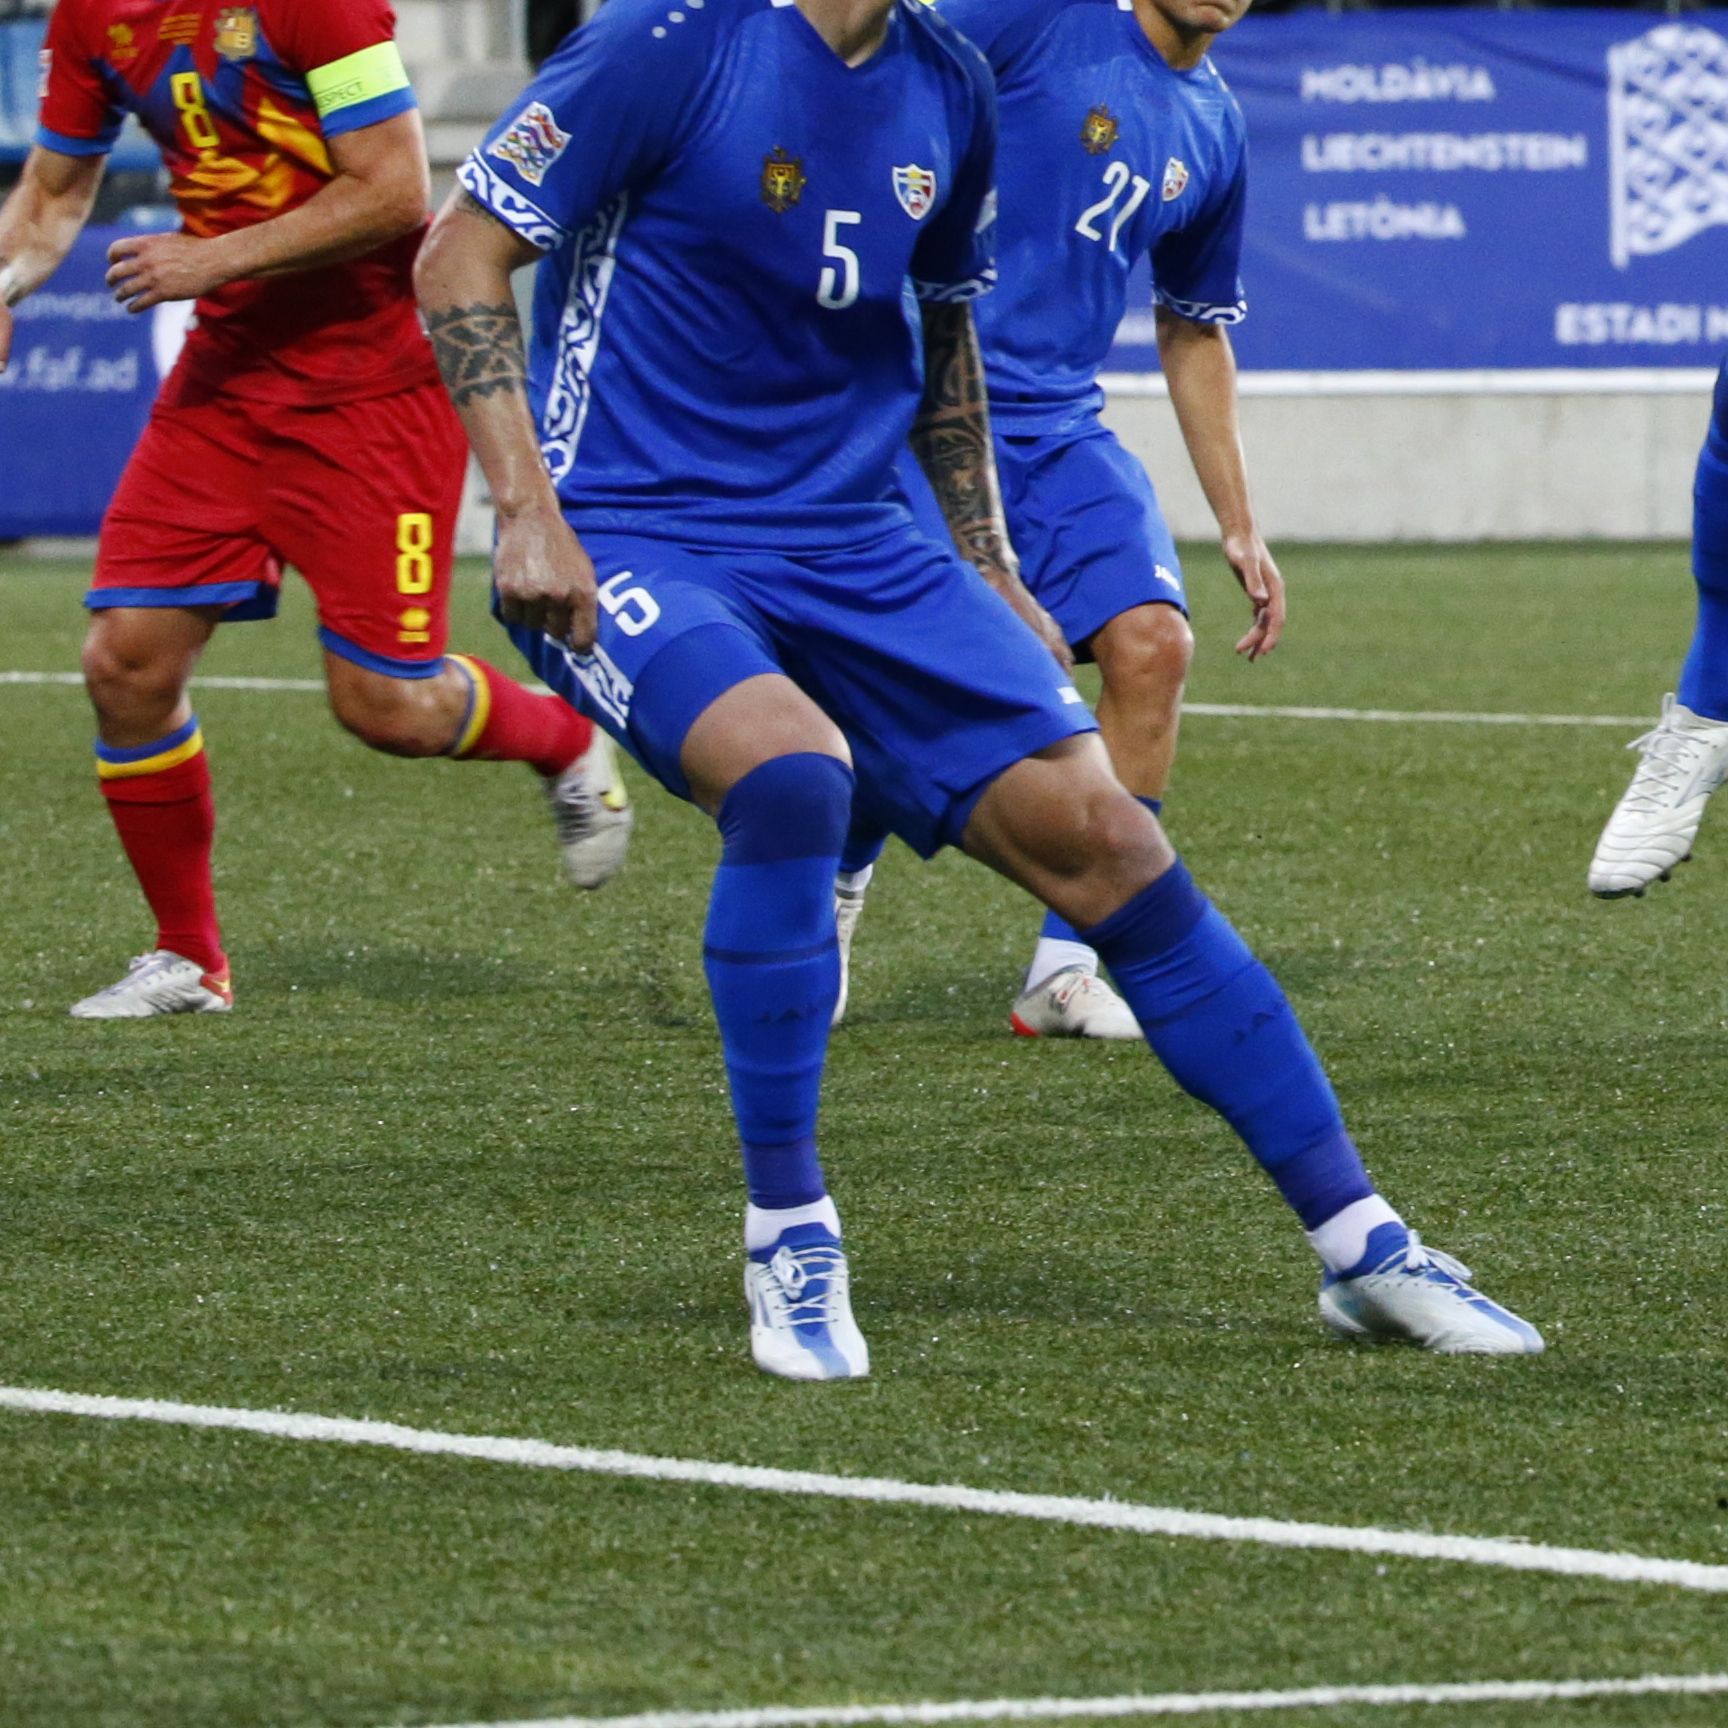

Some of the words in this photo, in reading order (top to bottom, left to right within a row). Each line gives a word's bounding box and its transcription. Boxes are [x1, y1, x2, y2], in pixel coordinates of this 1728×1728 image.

[170, 71, 220, 148] 8
[1074, 160, 1151, 252] 21
[815, 209, 862, 309] 5
[396, 512, 433, 594] 8
[597, 570, 661, 637] 5
